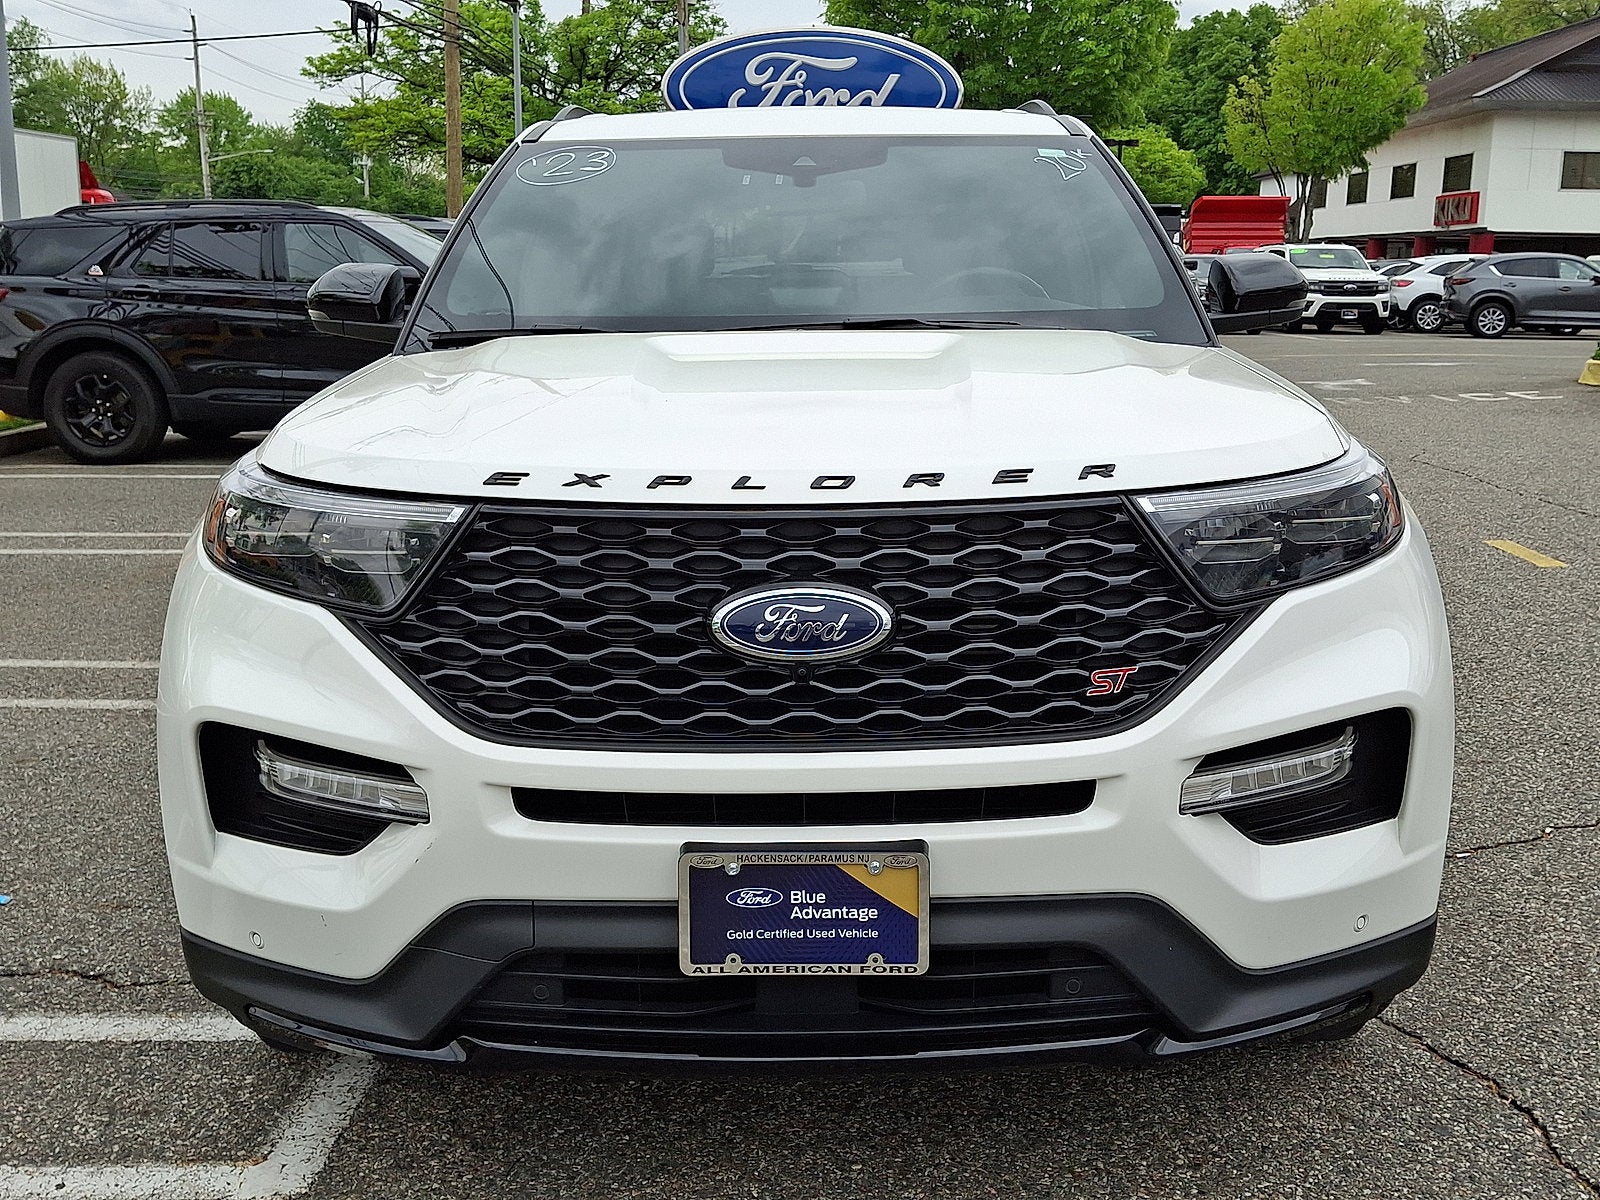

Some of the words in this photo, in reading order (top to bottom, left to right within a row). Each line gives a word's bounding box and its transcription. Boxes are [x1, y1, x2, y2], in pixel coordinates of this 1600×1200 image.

[482, 463, 1116, 490] EXPLORER
[755, 603, 850, 642] Ford
[1086, 666, 1139, 696] ST
[696, 856, 718, 866] Ford
[736, 854, 855, 864] HACKENSACK/PARAMUS
[857, 854, 870, 864] NJ
[890, 856, 912, 866] Ford
[736, 890, 772, 905] Ford
[790, 890, 826, 904] Blue
[790, 906, 878, 921] Advantage
[726, 929, 754, 940] Gold
[756, 929, 804, 940] Certified
[806, 928, 836, 939] Used
[838, 928, 879, 939] Vehicle
[692, 965, 731, 974] ALL
[738, 965, 852, 974] AMERICAN
[859, 965, 919, 974] FORD
